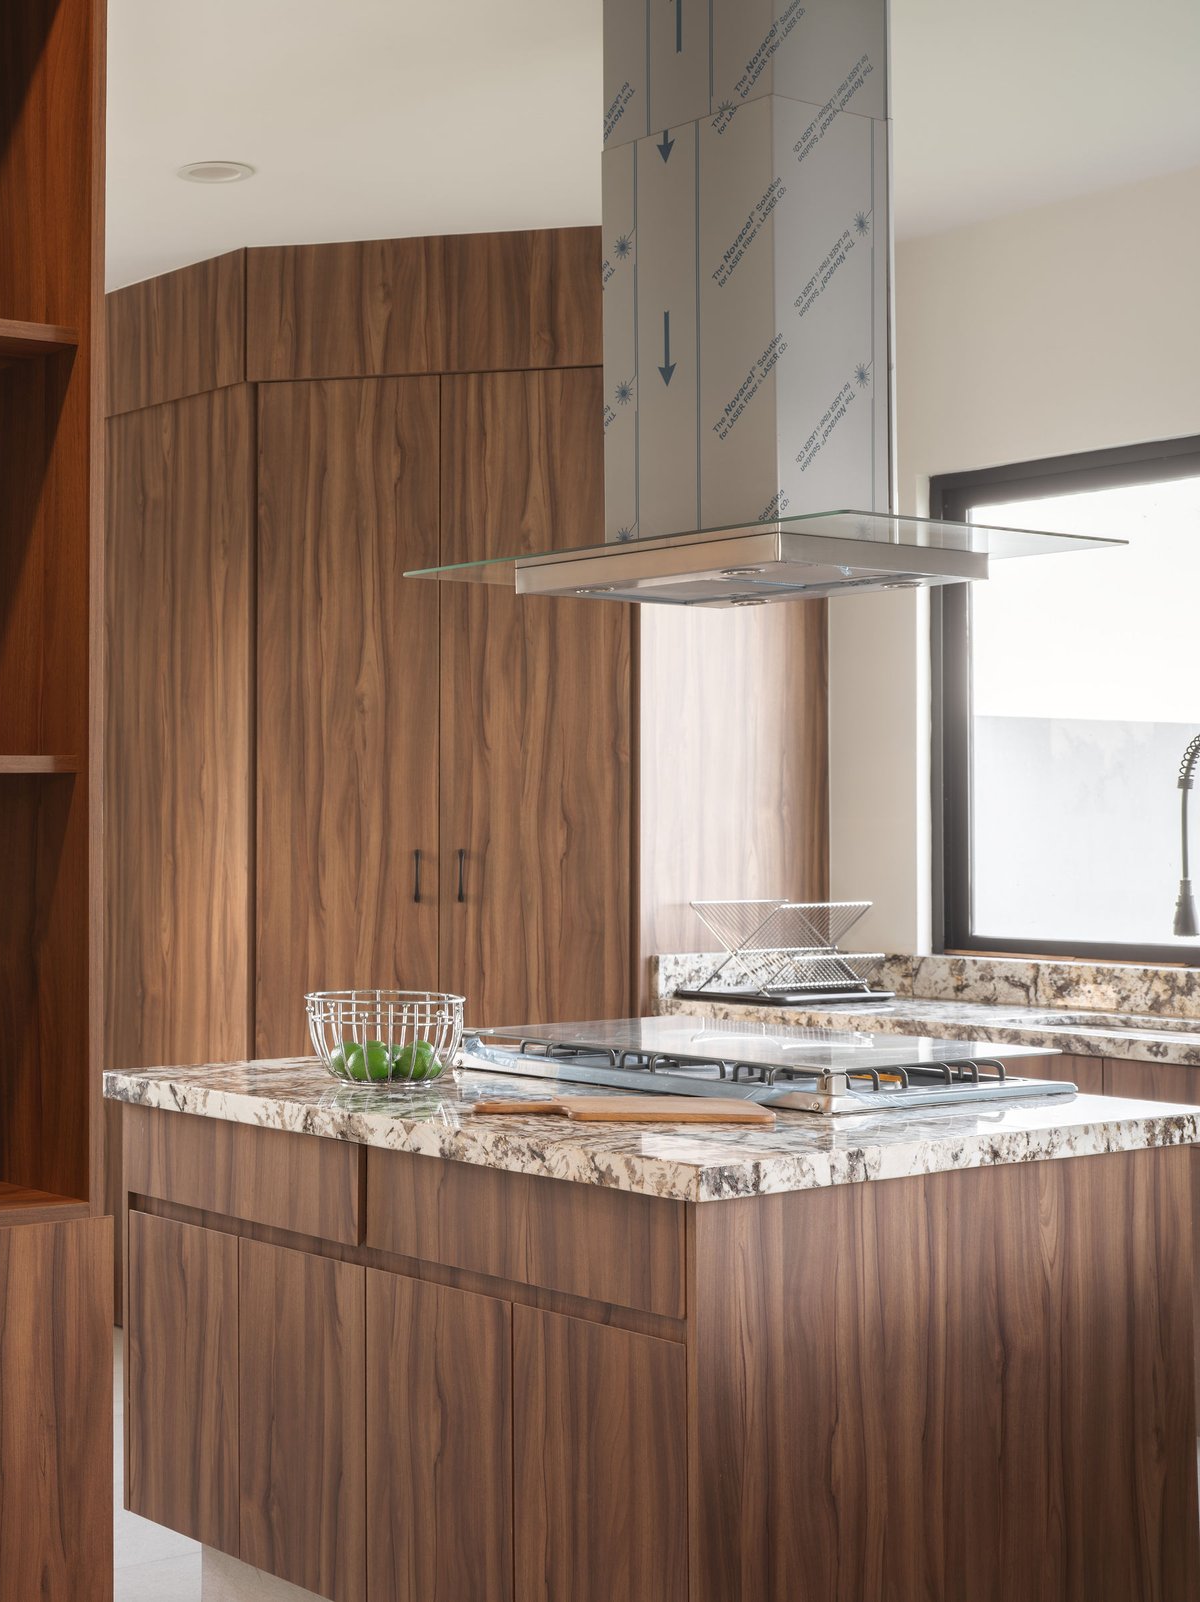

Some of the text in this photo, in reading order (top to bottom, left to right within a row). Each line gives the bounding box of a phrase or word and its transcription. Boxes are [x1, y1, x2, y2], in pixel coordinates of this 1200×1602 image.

[740, 86, 751, 98] for
[749, 58, 767, 86] LASER
[765, 41, 781, 58] Fiber
[782, 17, 798, 37] LASER
[847, 62, 862, 83] LASER
[863, 63, 874, 77] The
[734, 75, 747, 92] The
[711, 110, 725, 127] The
[717, 106, 737, 135] for LAS
[801, 122, 817, 144] LASER
[711, 264, 726, 280] The
[755, 177, 782, 212] Solution
[842, 229, 851, 241] for
[718, 275, 728, 288] for
[725, 249, 745, 276] LASER
[742, 228, 758, 249] Fiber
[758, 196, 778, 223] LASER
[828, 238, 844, 260] LASER
[844, 239, 856, 252] The
[818, 257, 831, 274] Fiber
[801, 276, 818, 298] LASER
[799, 288, 820, 317] Solution
[712, 416, 727, 433] The
[756, 332, 784, 368] Solution
[842, 381, 851, 393] for
[718, 428, 729, 440] for
[726, 403, 746, 429] LASER
[743, 383, 759, 404] Fiber
[760, 352, 780, 378] LASER
[829, 391, 845, 413] LASER
[844, 391, 856, 405] The
[819, 410, 832, 428] Fiber
[803, 430, 819, 452] LASER
[800, 442, 821, 472] Solution
[758, 489, 785, 521] Solution
